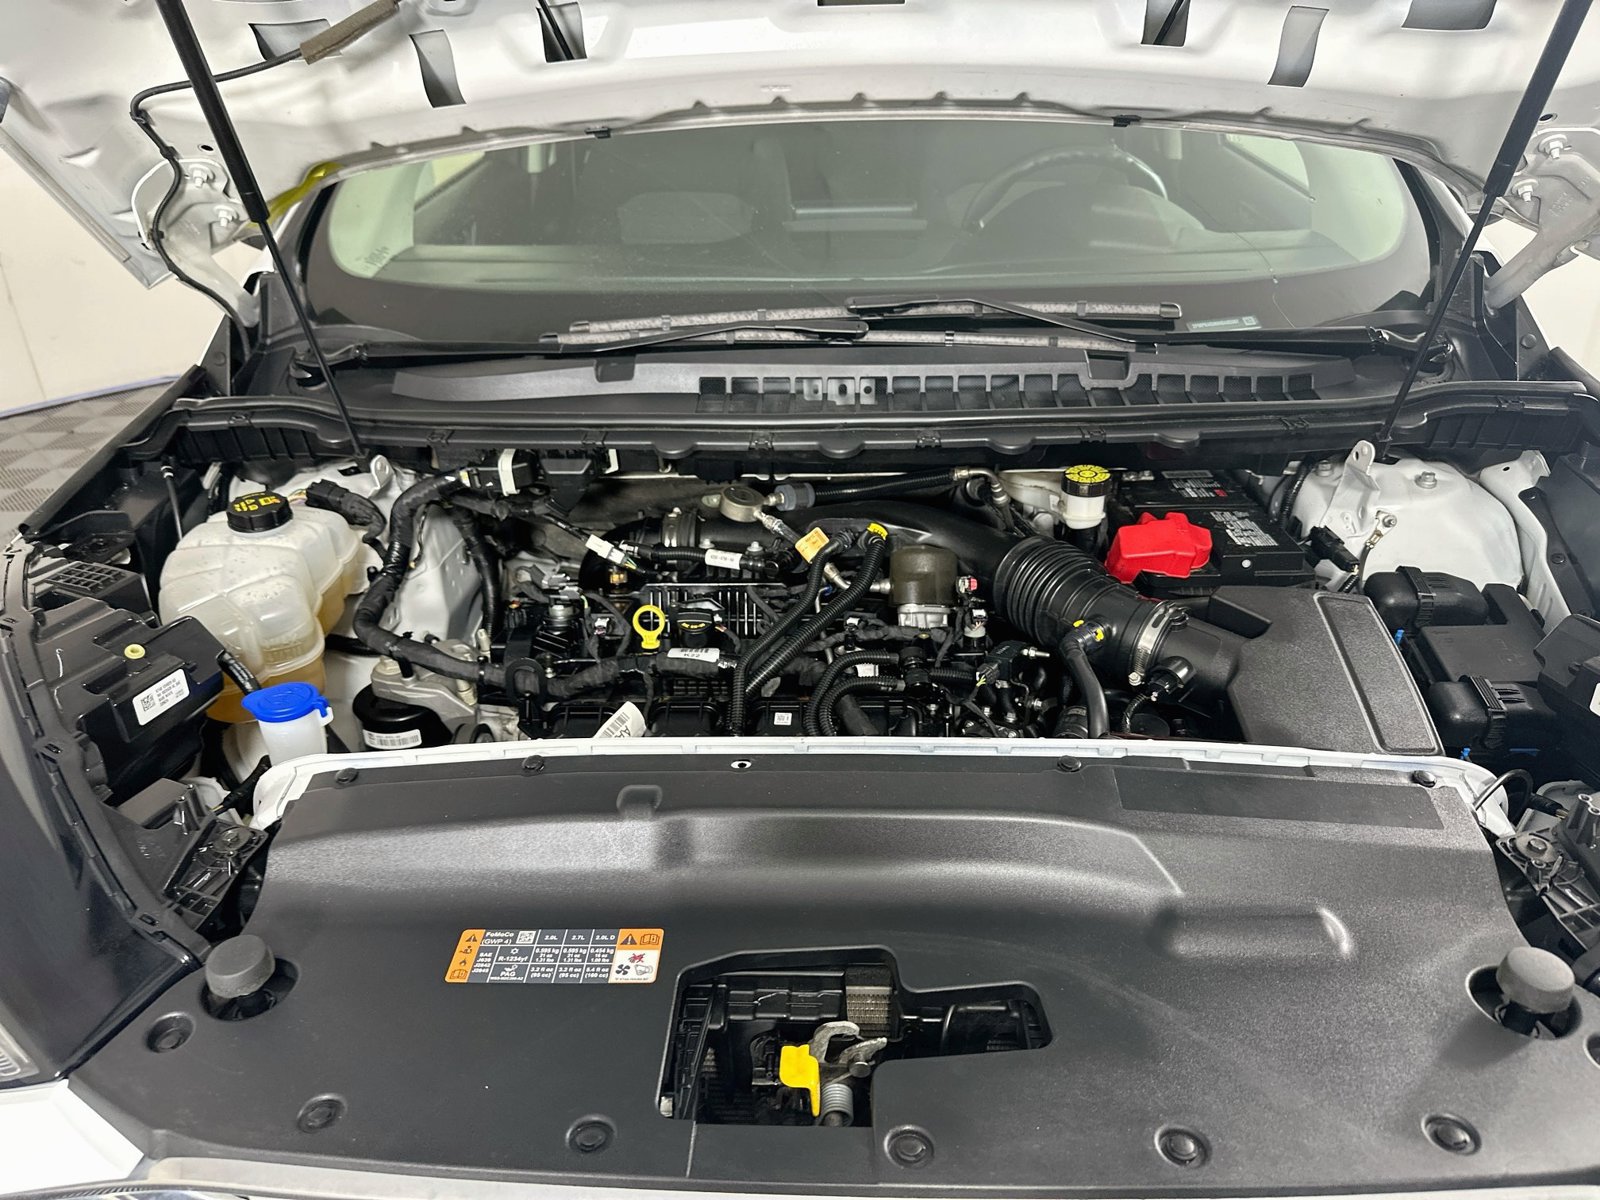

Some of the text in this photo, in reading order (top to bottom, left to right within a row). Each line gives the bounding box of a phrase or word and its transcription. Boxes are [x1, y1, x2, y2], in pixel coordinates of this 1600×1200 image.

[551, 947, 560, 955] kg
[579, 947, 587, 955] kg
[606, 947, 615, 955] kg
